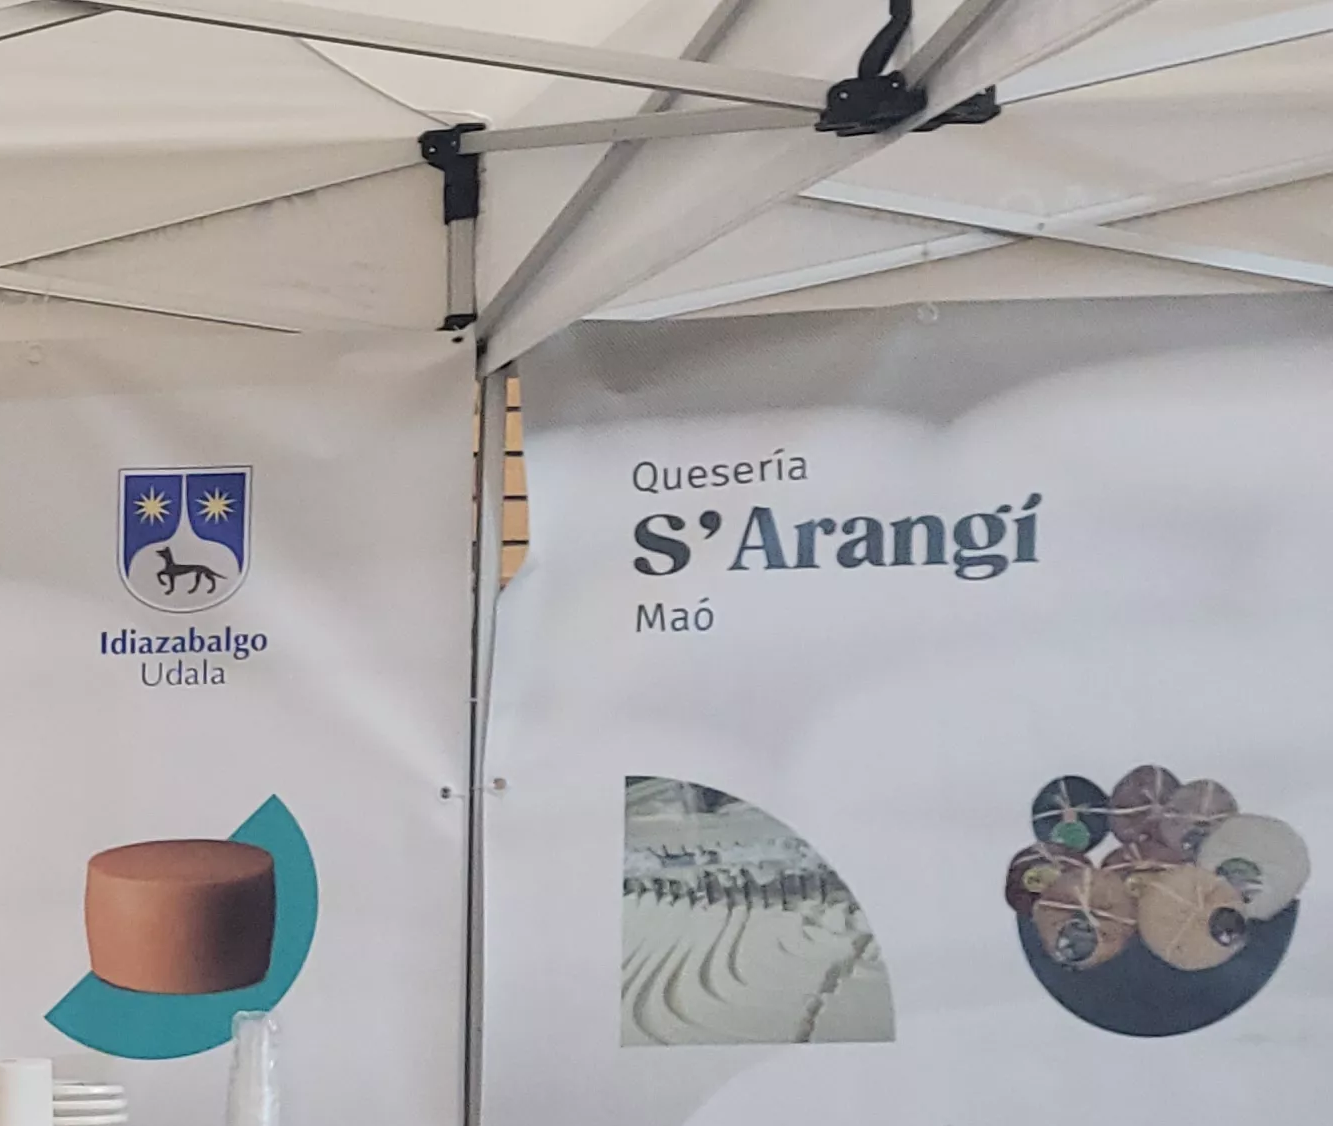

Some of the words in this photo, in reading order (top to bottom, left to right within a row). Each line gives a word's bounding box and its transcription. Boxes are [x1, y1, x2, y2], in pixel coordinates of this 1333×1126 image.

[633, 448, 808, 494] Quesería
[635, 597, 715, 633] Maó
[100, 626, 268, 661] Idiazabalgo
[141, 658, 226, 687] Udala
